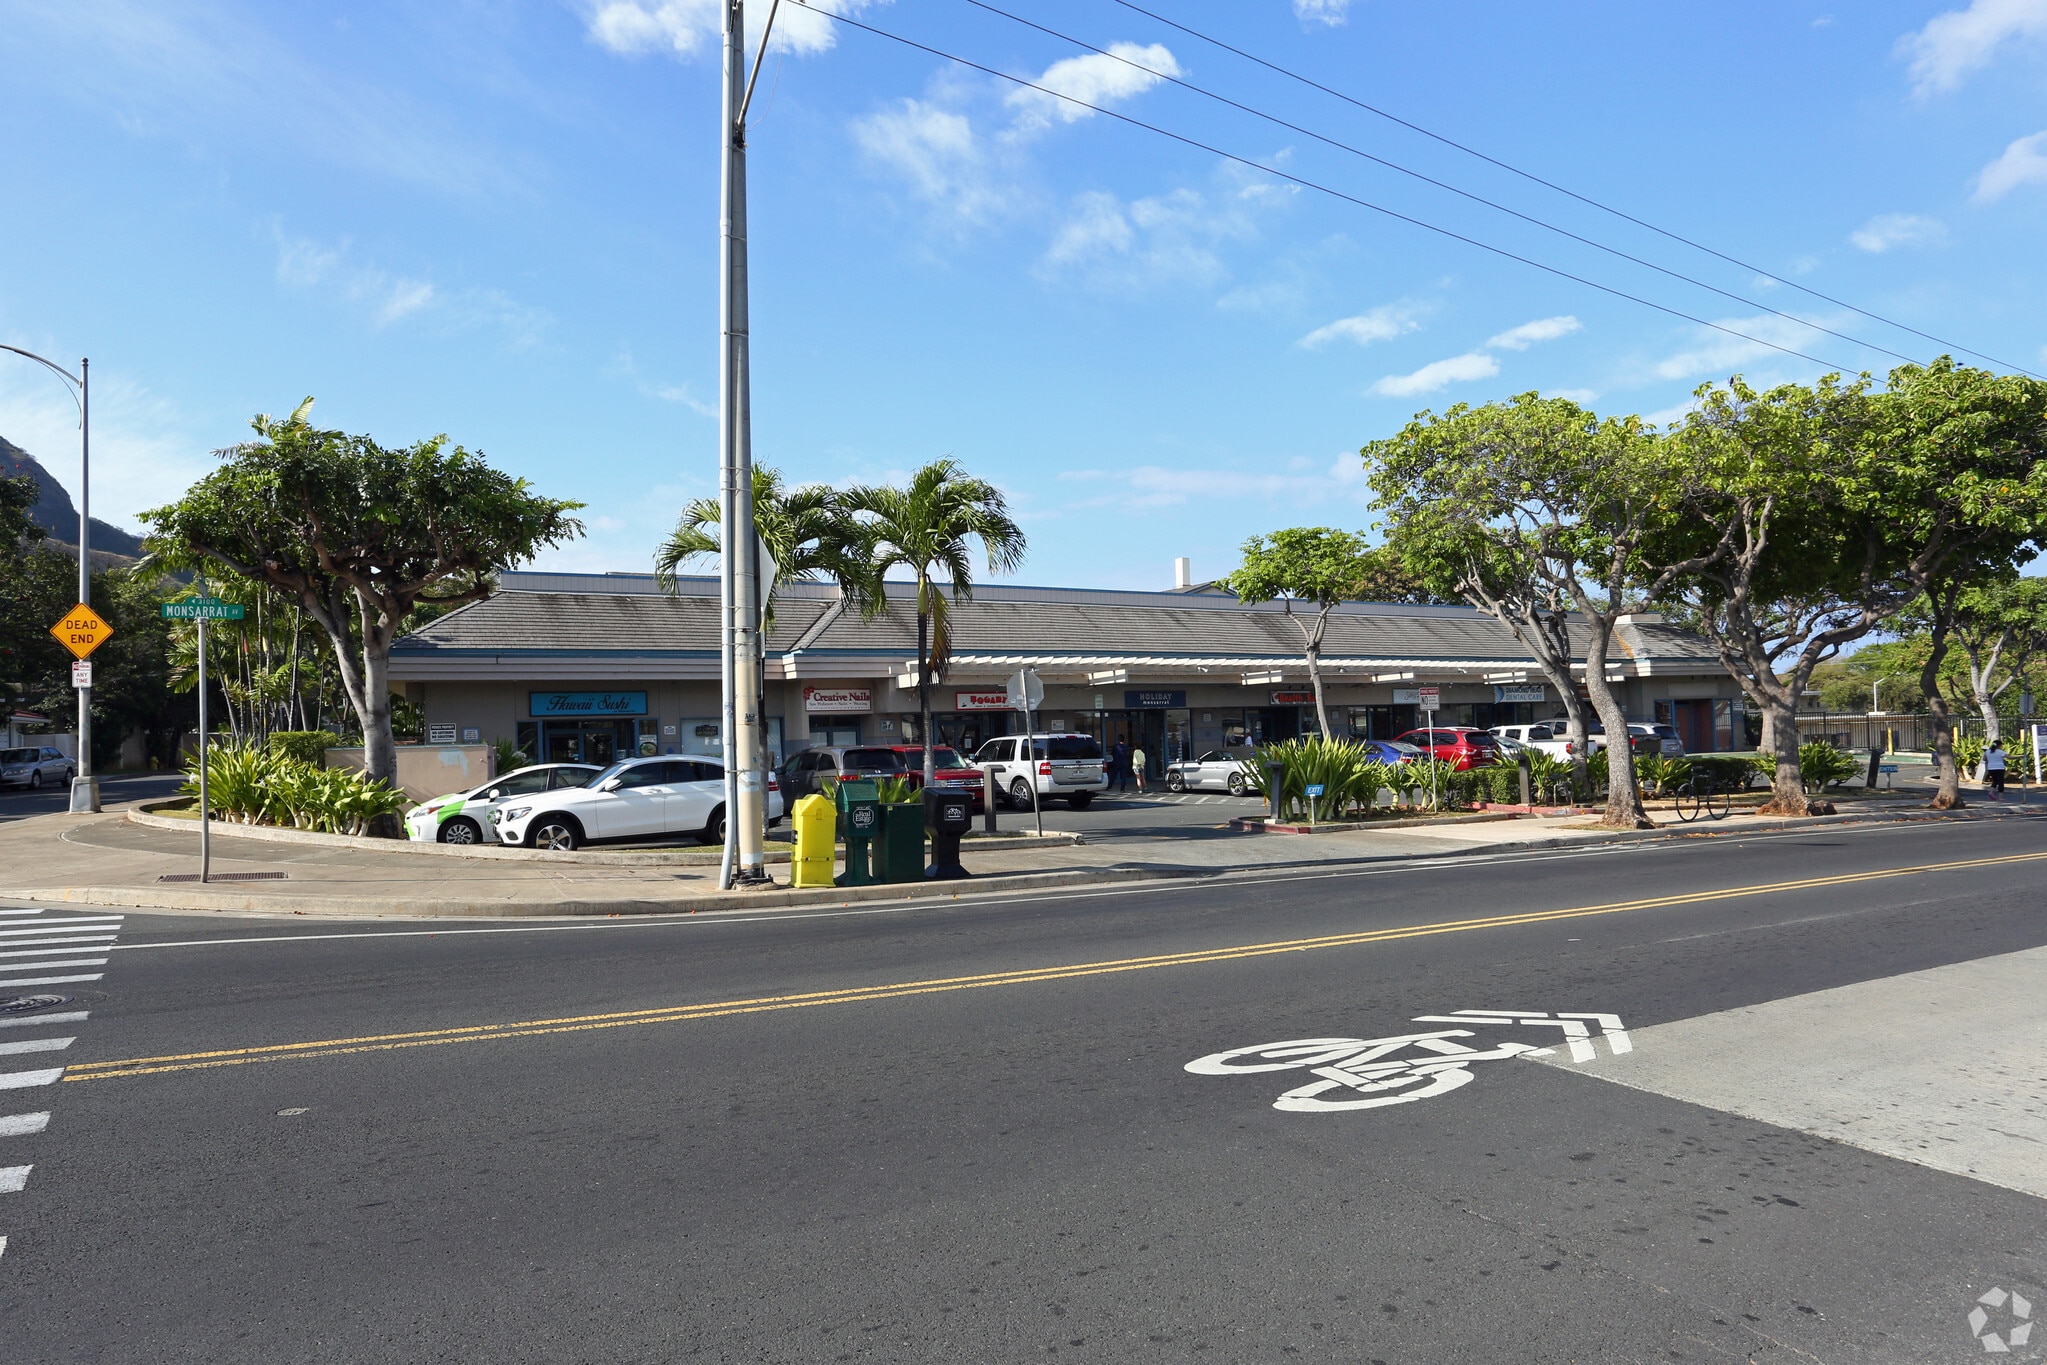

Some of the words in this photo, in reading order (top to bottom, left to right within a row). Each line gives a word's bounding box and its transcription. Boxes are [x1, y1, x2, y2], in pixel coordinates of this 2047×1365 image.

[166, 605, 228, 617] MONSARRAT
[66, 620, 98, 630] DEAD
[70, 634, 94, 644] END
[813, 692, 848, 702] Creative
[849, 691, 870, 702] Nails
[970, 695, 1008, 705] BOGART
[1506, 693, 1527, 701] DENTAL
[1528, 693, 1543, 701] CARE
[546, 694, 594, 711] Hawaii
[597, 694, 632, 711] Sushi
[1307, 786, 1321, 794] EXIT
